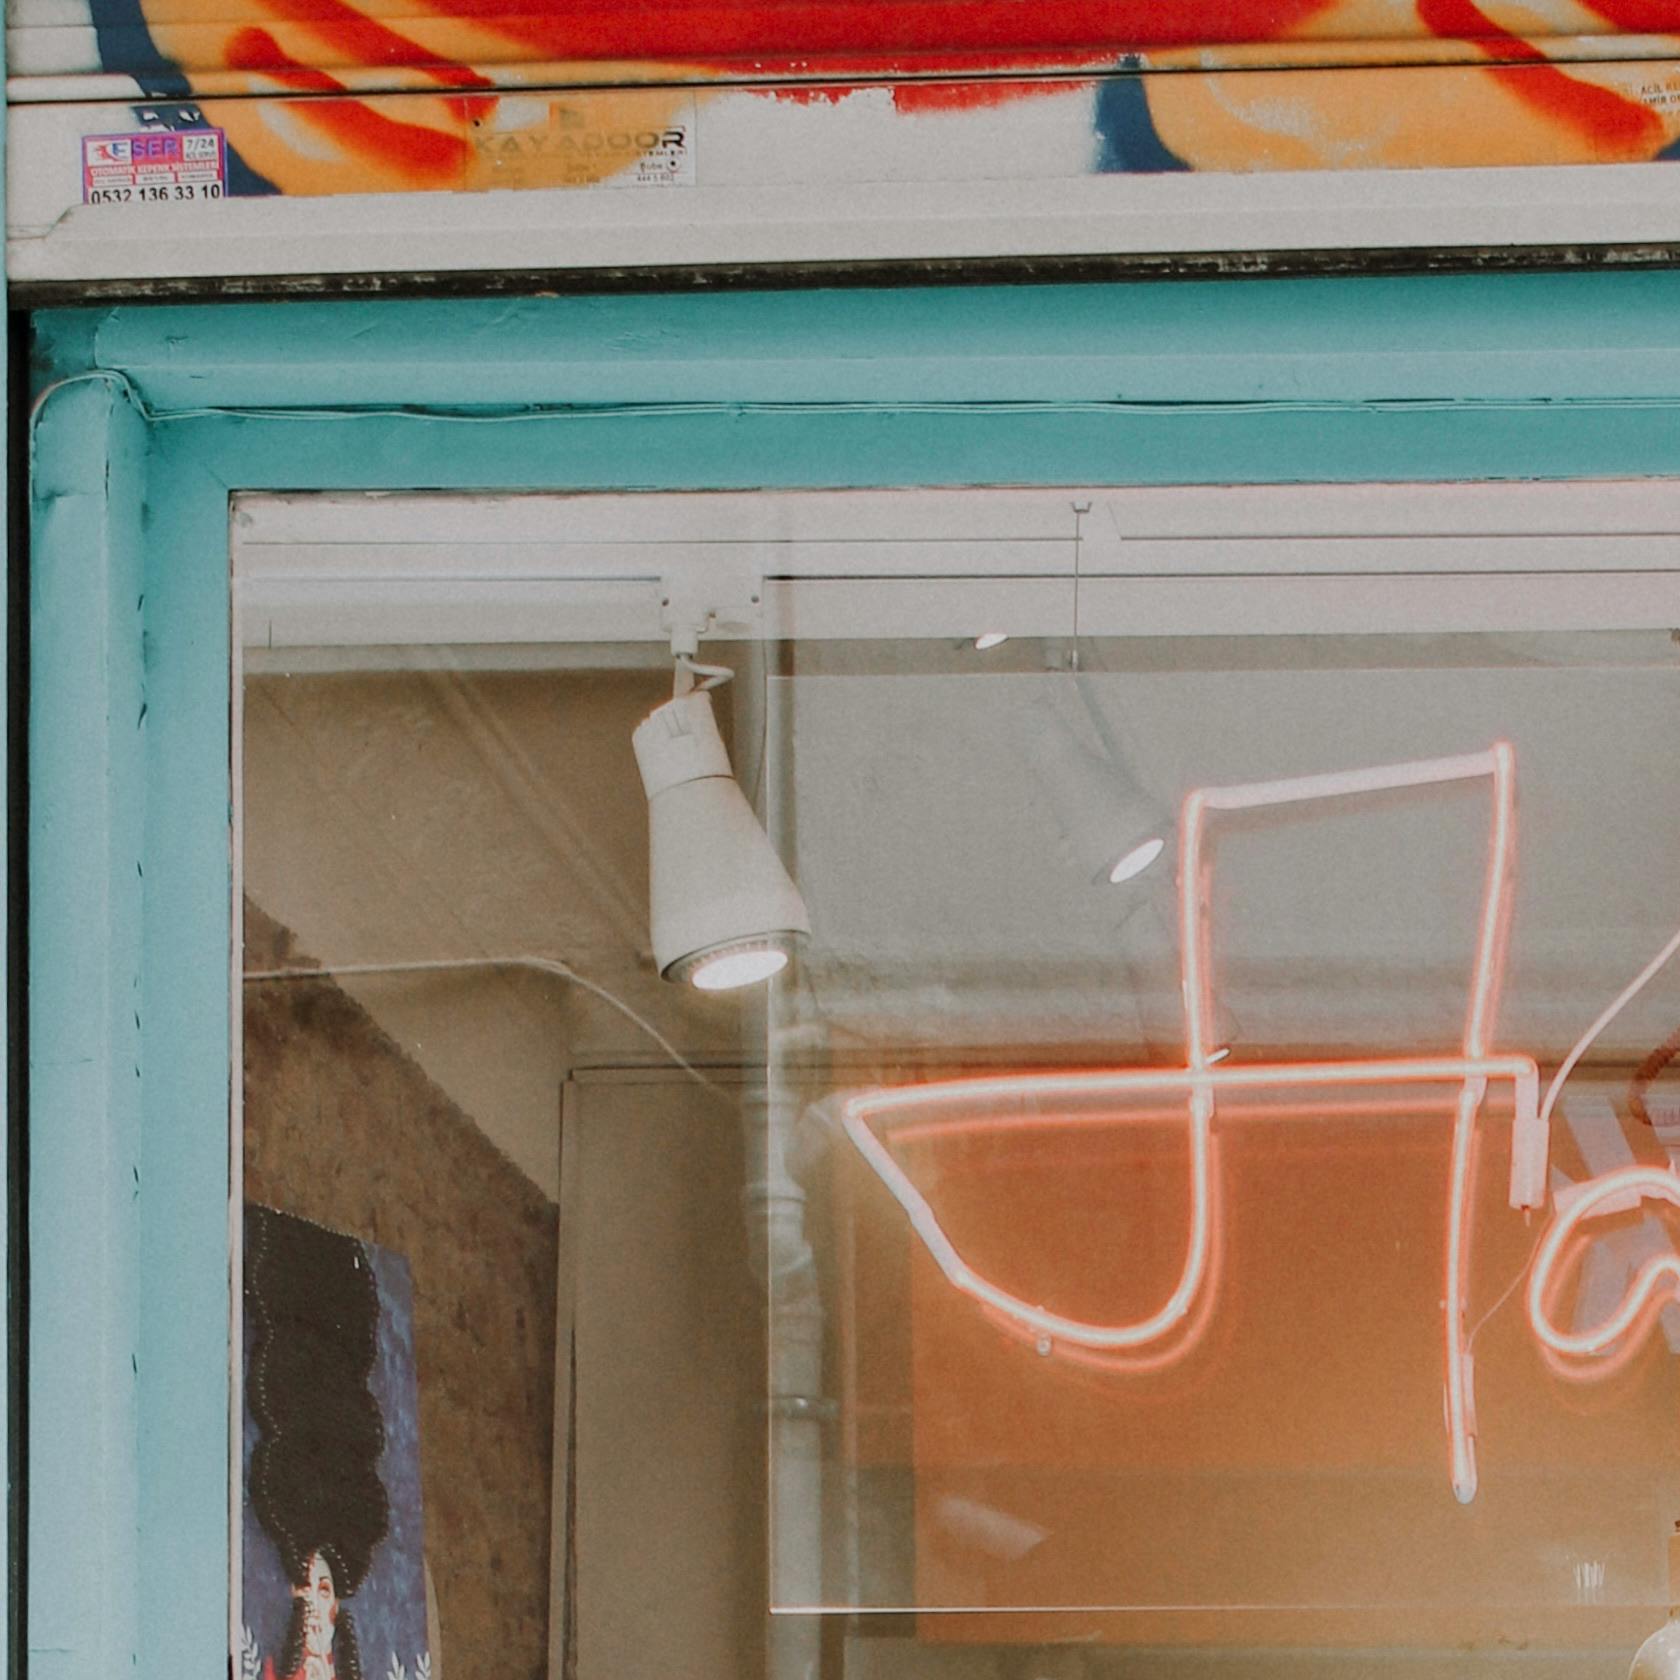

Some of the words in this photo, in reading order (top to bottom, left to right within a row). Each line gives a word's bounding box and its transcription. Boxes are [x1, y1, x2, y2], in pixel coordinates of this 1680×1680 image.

[91, 188, 132, 204] 0532
[139, 186, 168, 201] 136
[174, 185, 195, 200] 33
[202, 184, 220, 199] 10
